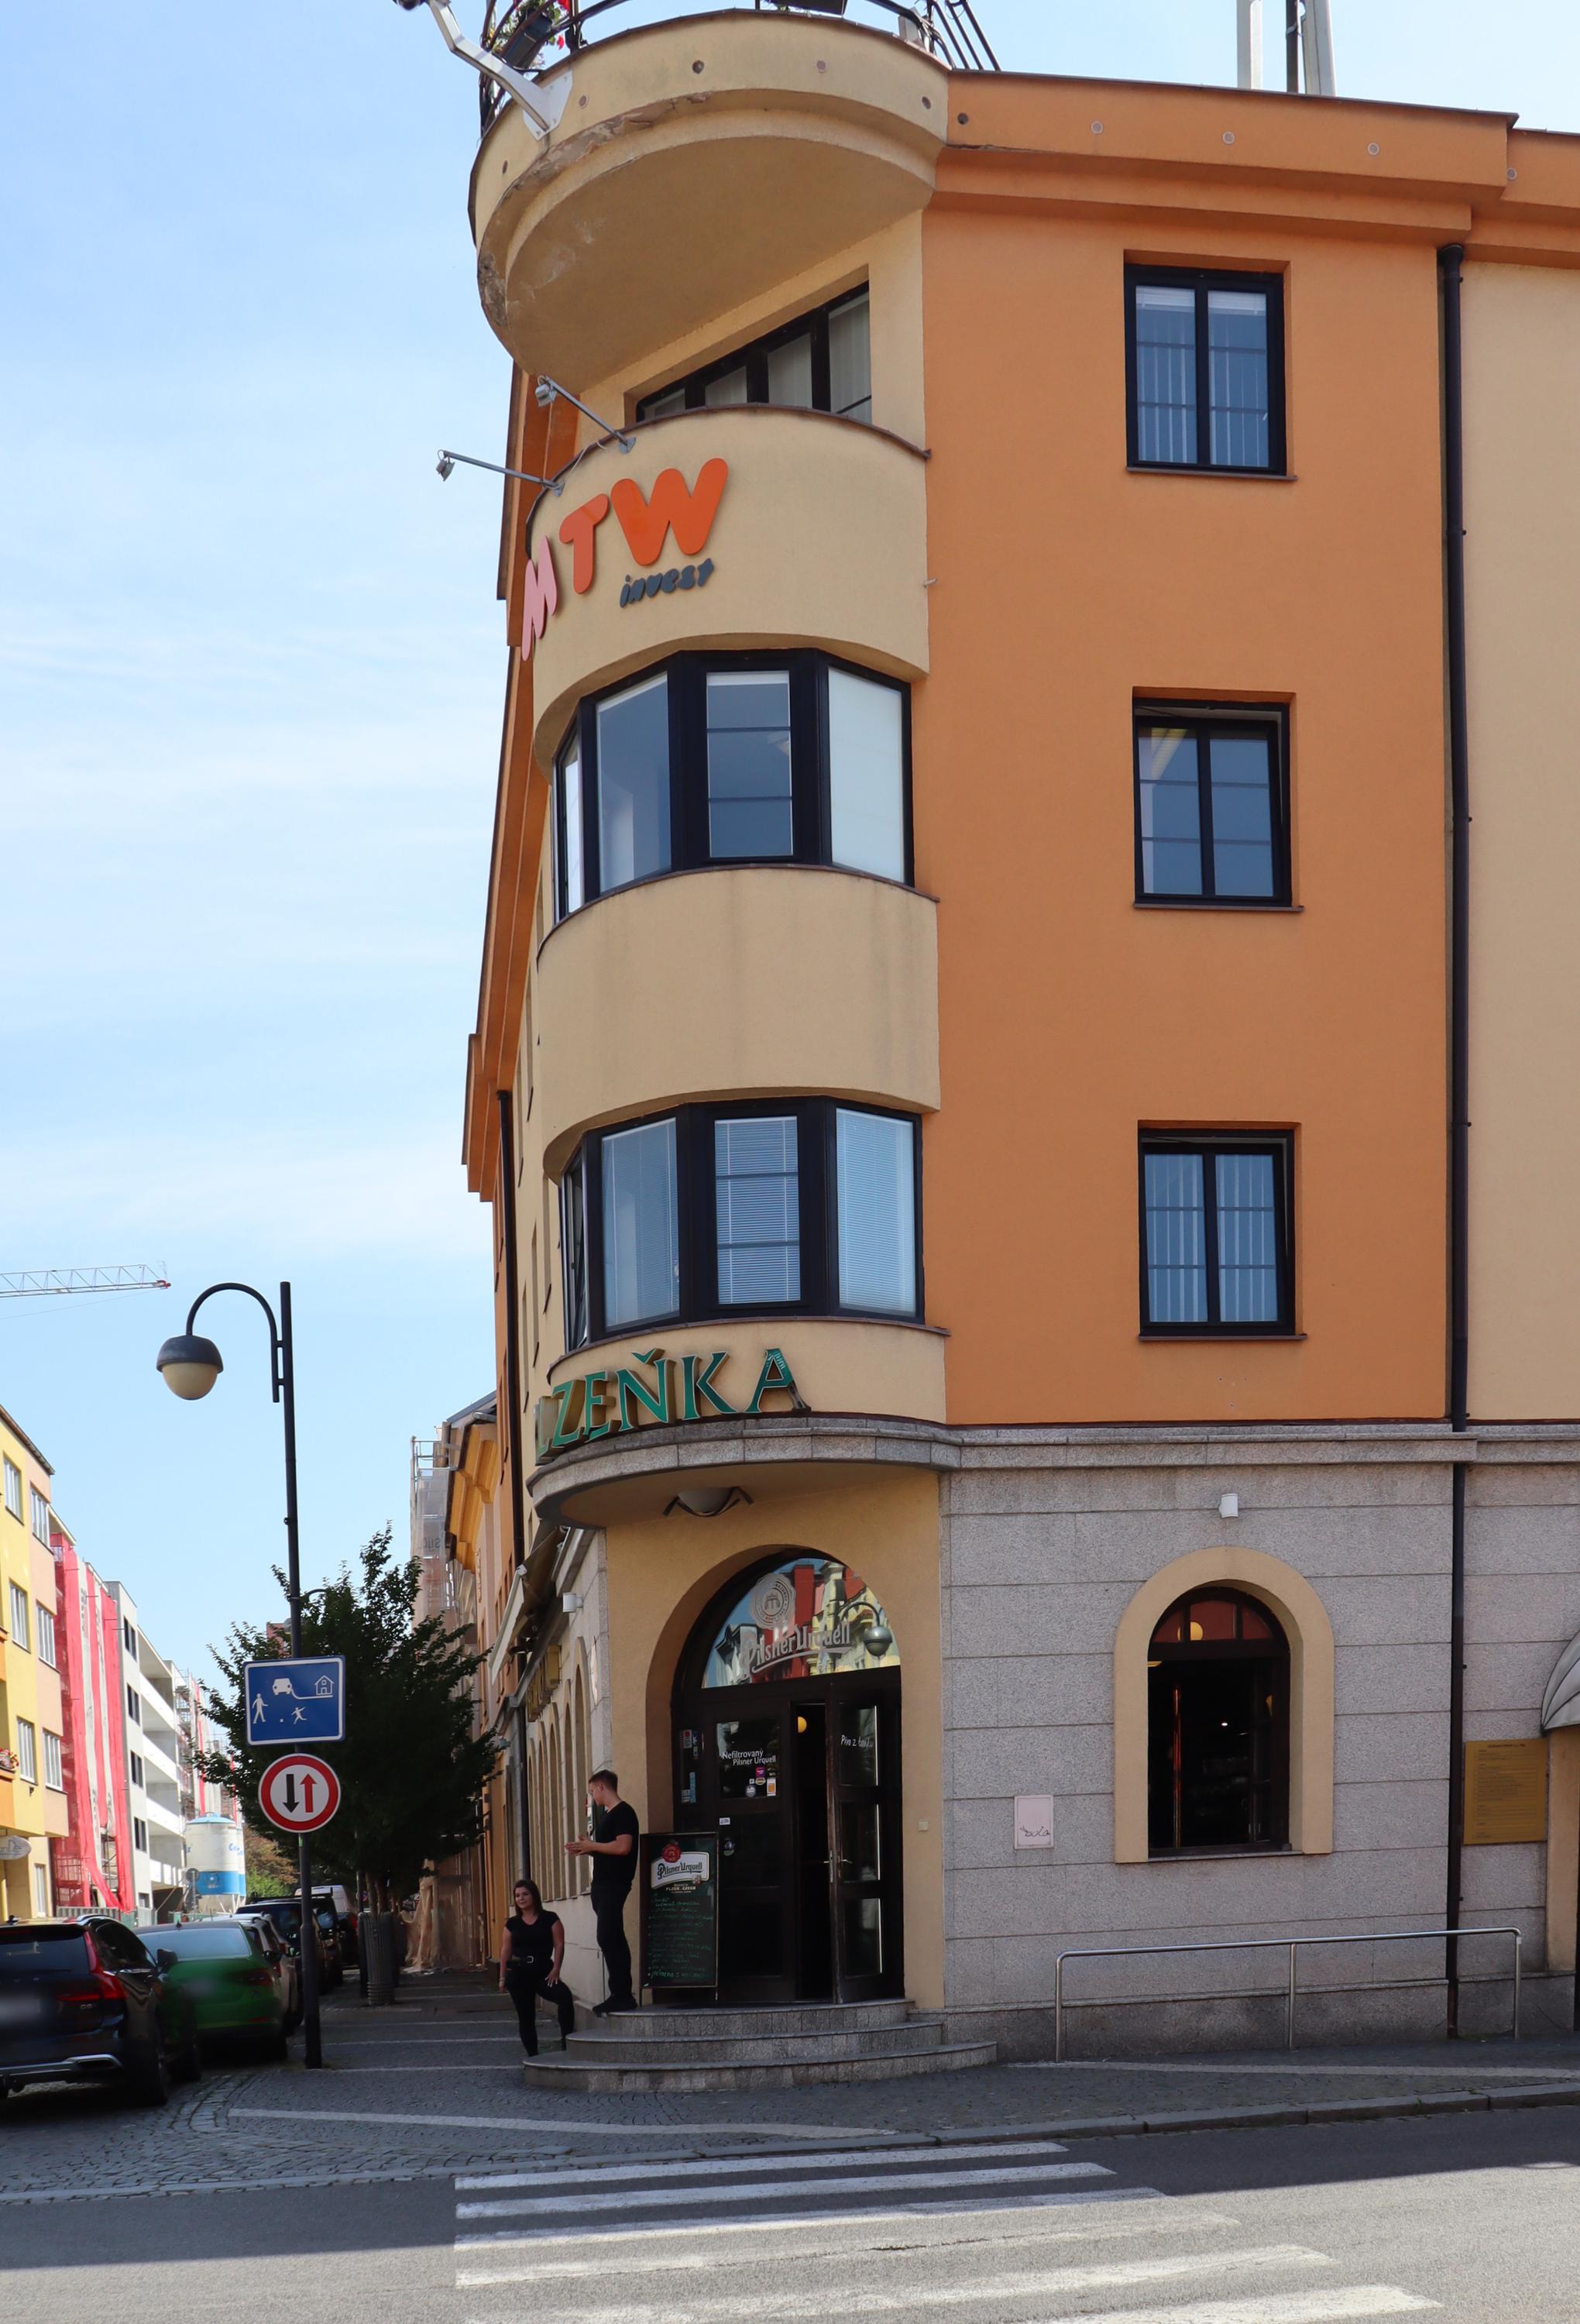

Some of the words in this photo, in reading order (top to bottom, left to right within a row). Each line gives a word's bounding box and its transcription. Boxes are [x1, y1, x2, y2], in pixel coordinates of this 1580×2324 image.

[520, 457, 729, 662] MTW
[620, 557, 714, 608] invest
[740, 1631, 795, 1678] Pilsner
[794, 1620, 850, 1672] Urquell
[852, 1738, 857, 1747] z
[722, 1748, 764, 1760] Nefiltrovaný
[733, 1758, 753, 1766] Pilsner
[754, 1755, 776, 1765] Urquell
[657, 1862, 680, 1880] Pilsner
[680, 1862, 702, 1874] Urquell
